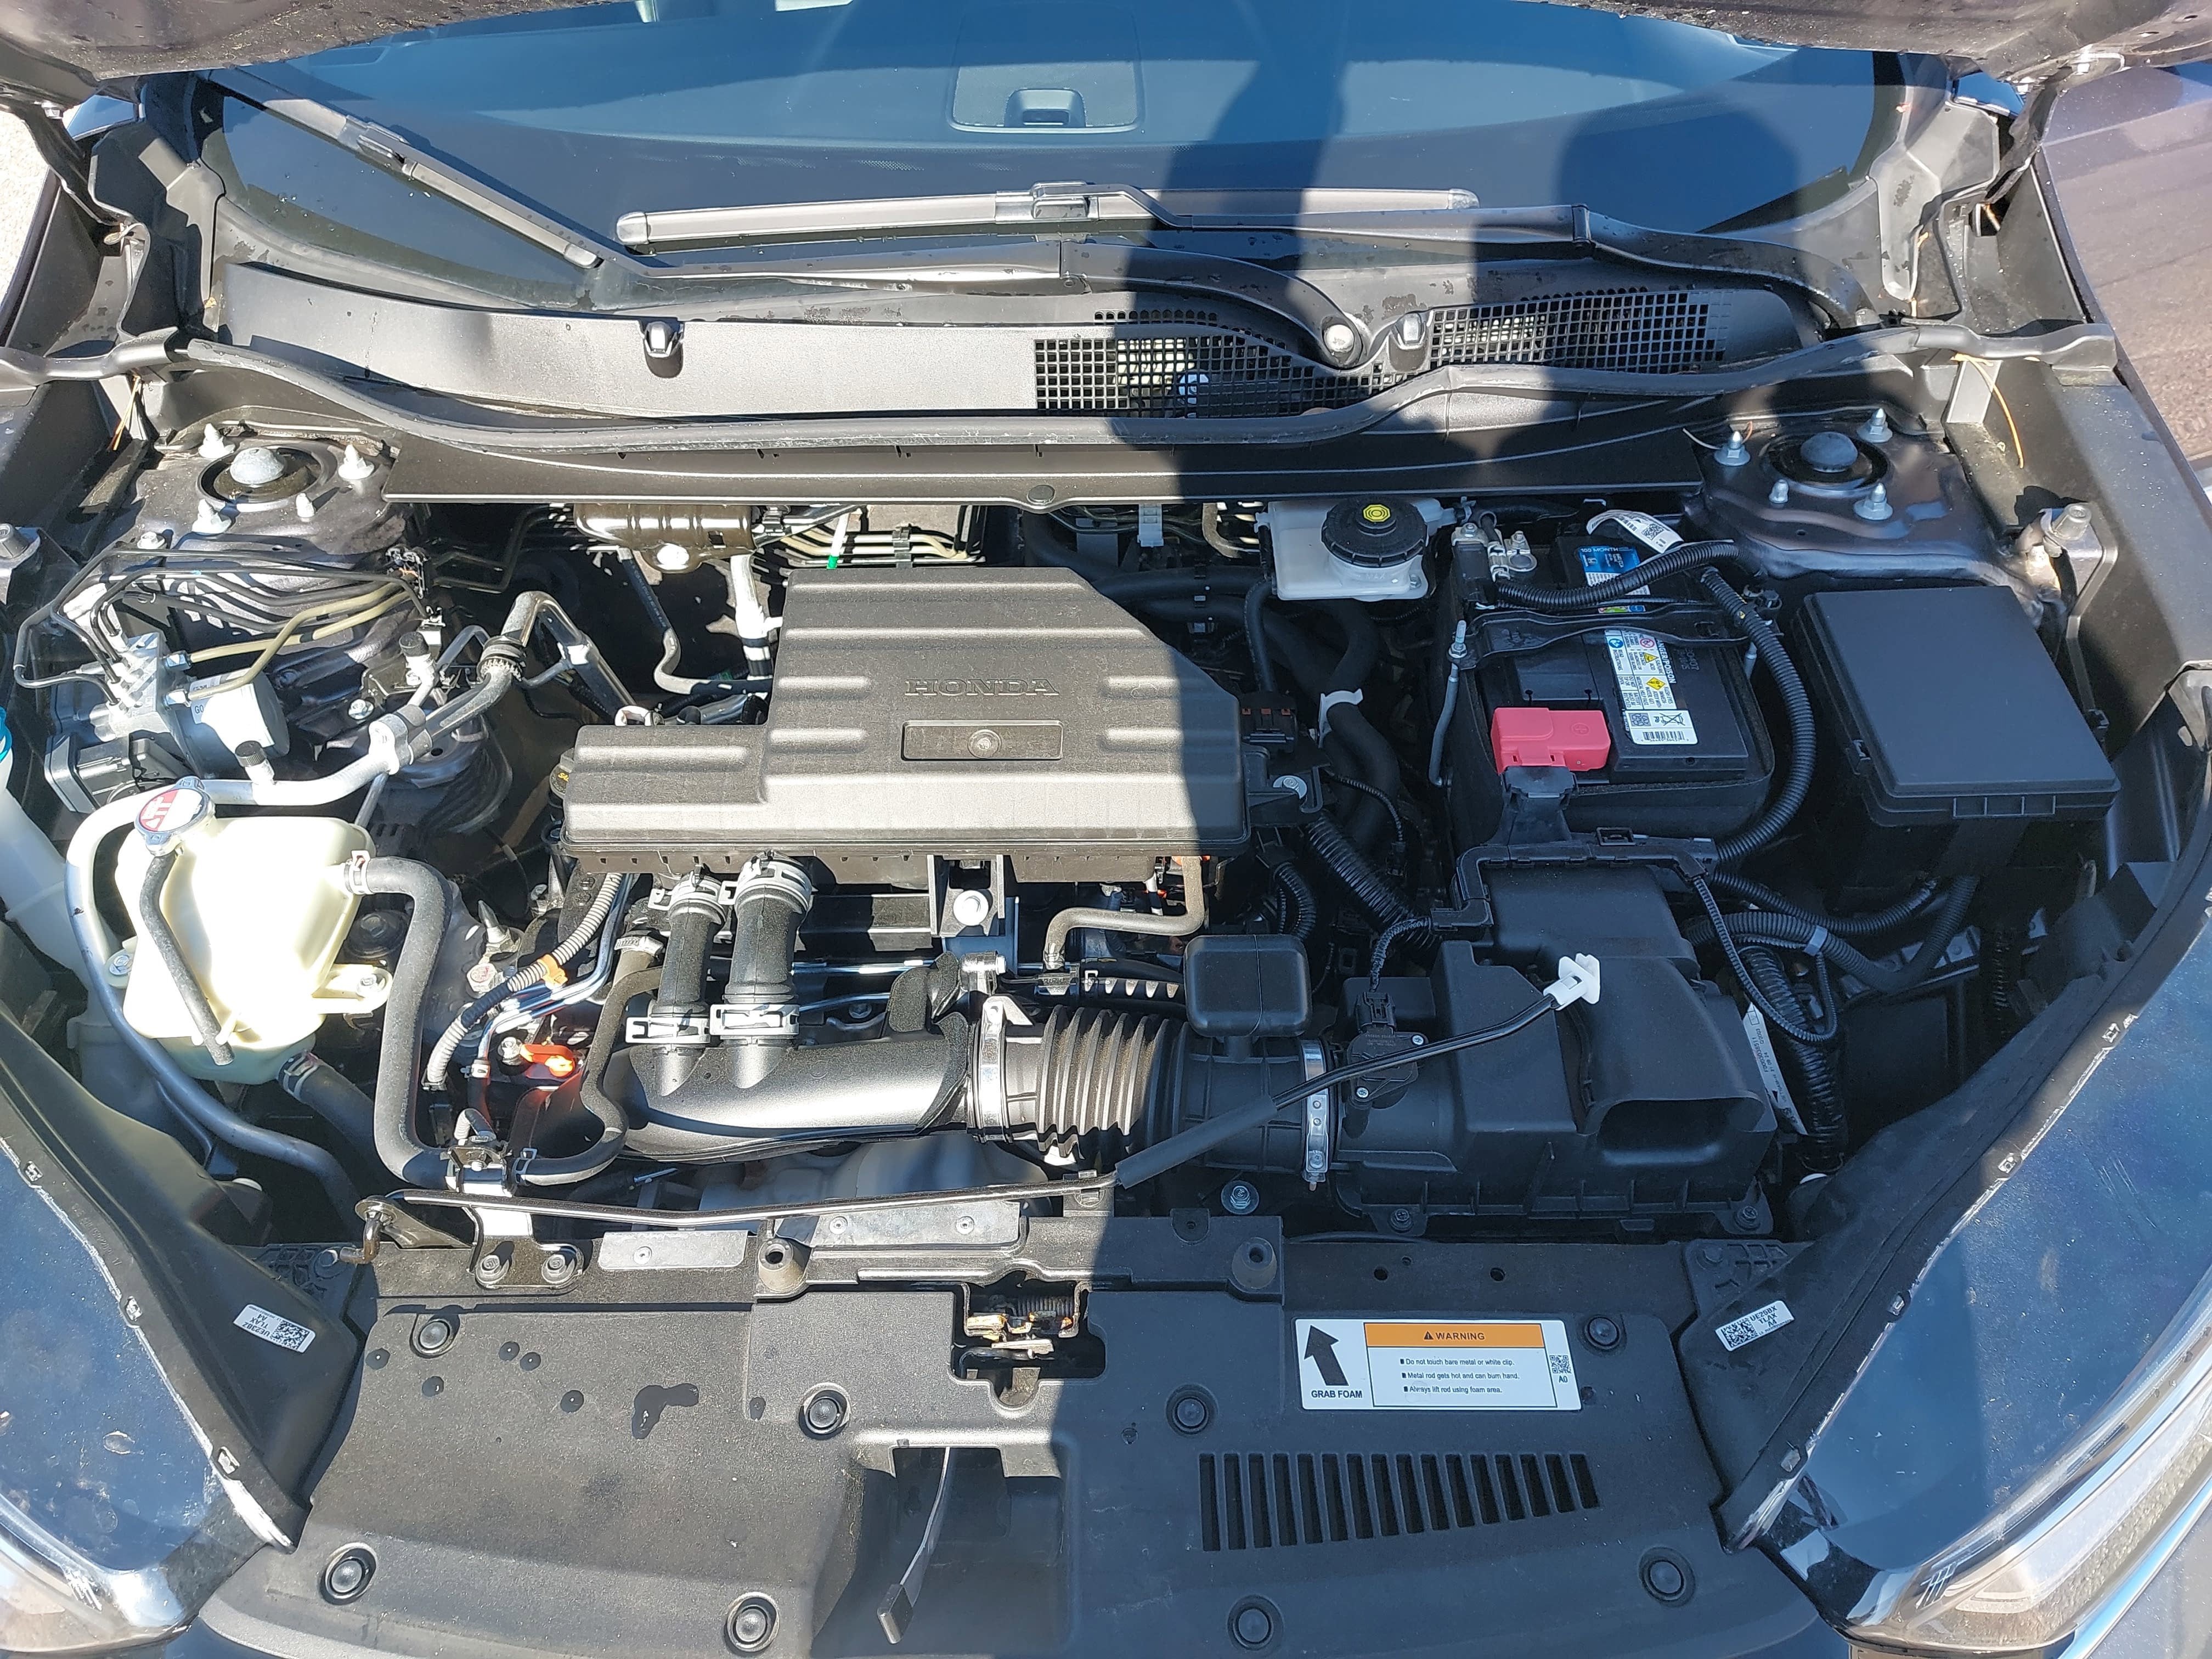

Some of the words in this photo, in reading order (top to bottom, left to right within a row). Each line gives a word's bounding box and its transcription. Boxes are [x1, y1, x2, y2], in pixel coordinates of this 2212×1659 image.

[1656, 639, 1677, 683] ANGER/POISON
[905, 679, 1059, 696] HONDA
[250, 1317, 268, 1329] TLAX
[1758, 1313, 1778, 1324] TLAX
[1435, 1332, 1485, 1341] WARNING
[1311, 1390, 1336, 1398] GRAB
[1338, 1390, 1363, 1398] FOAM
